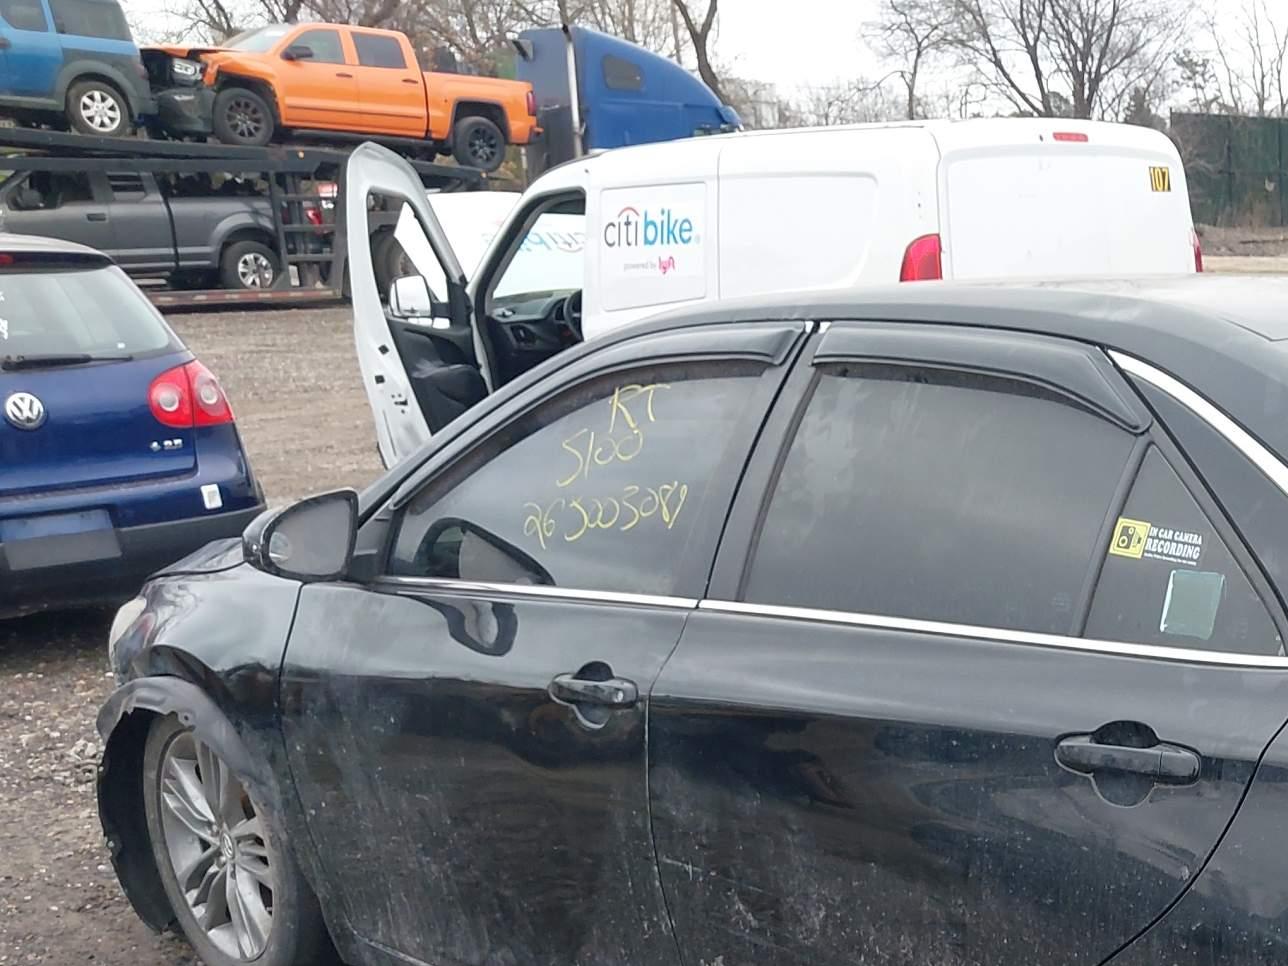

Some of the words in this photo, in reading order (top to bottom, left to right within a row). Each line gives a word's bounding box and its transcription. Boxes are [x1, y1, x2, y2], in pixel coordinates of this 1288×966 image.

[1150, 166, 1168, 192] 107
[604, 208, 640, 248] citi
[643, 208, 693, 246] bike
[1149, 527, 1159, 536] IN
[1158, 528, 1174, 540] CAR
[1173, 531, 1202, 545] CAMERA
[1145, 538, 1201, 560] RECORDING
